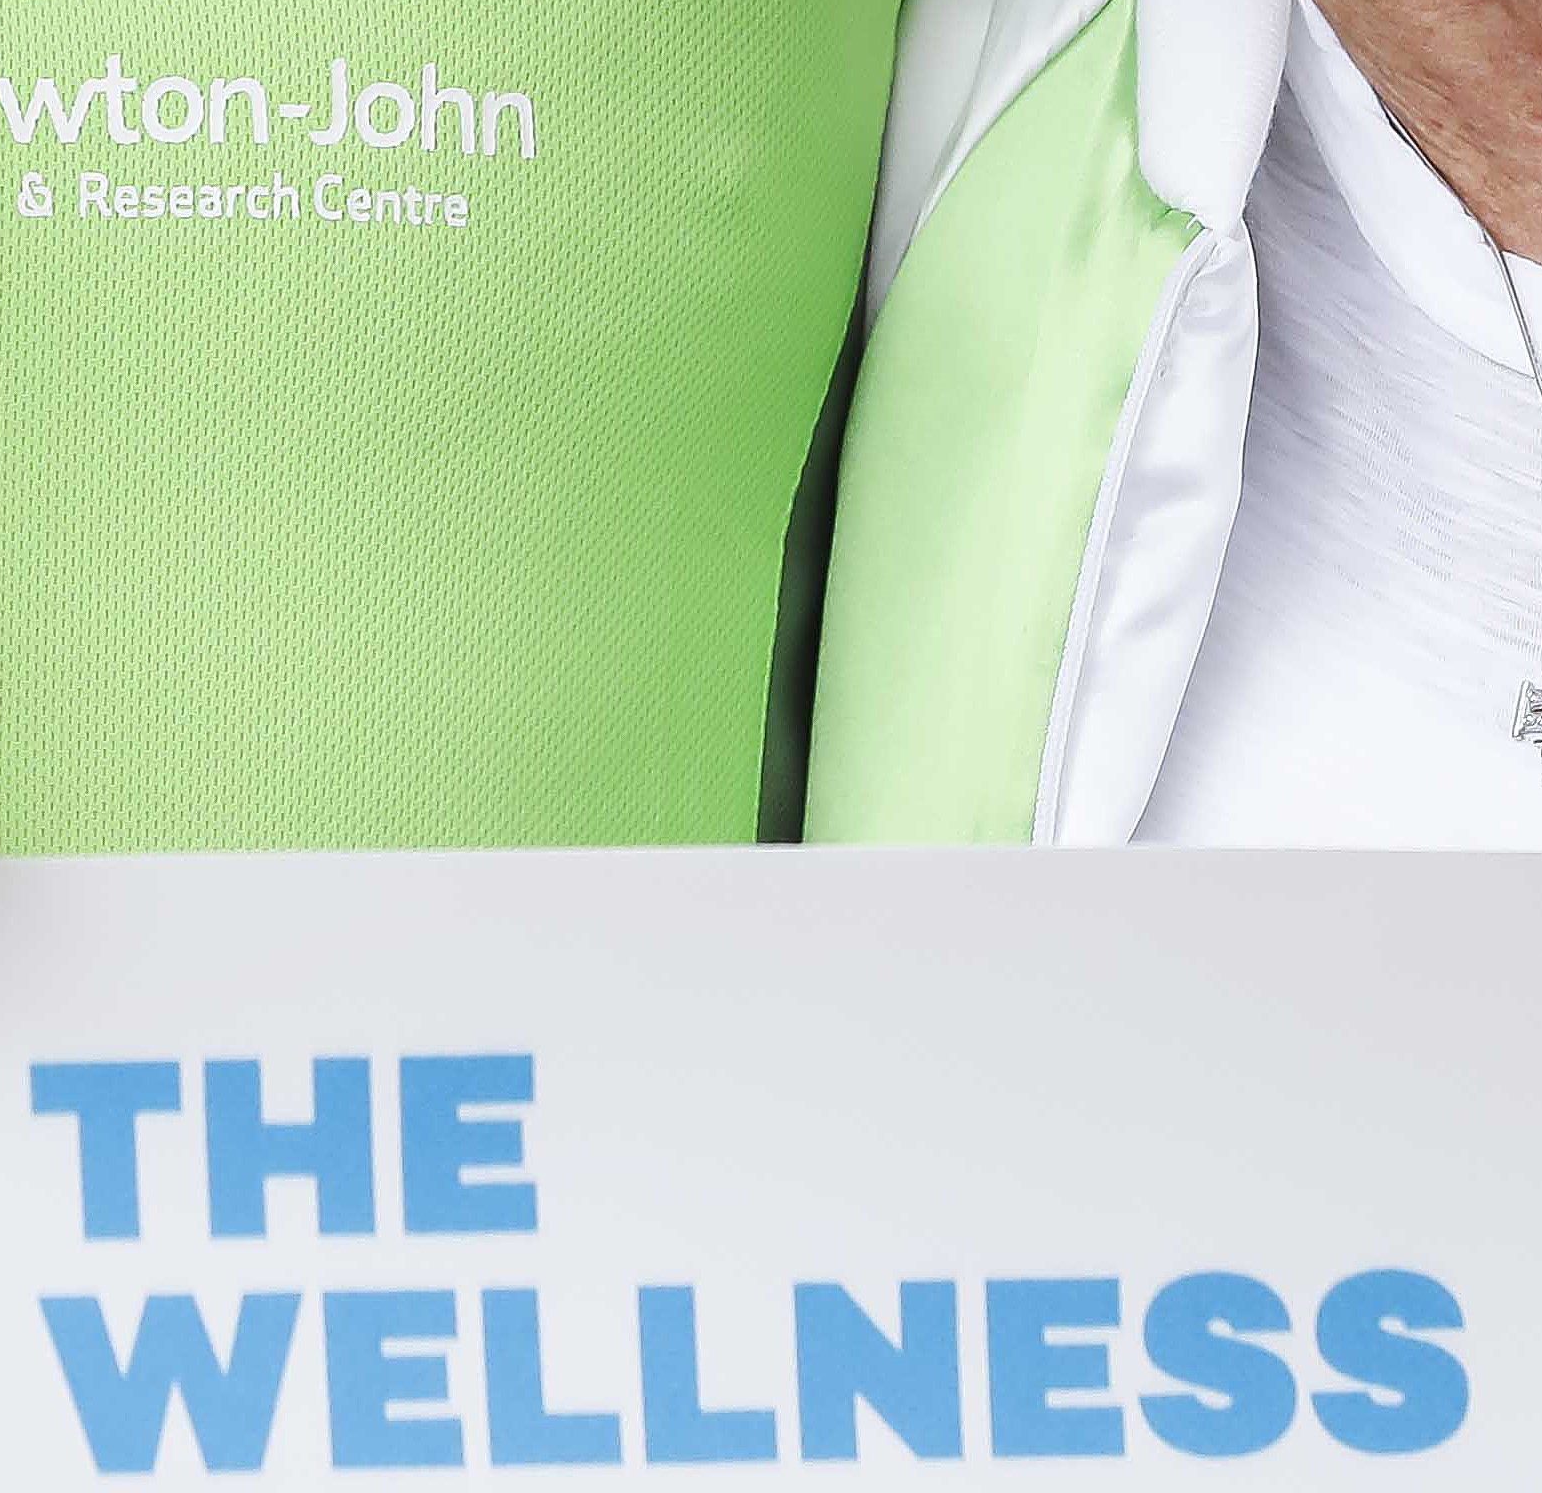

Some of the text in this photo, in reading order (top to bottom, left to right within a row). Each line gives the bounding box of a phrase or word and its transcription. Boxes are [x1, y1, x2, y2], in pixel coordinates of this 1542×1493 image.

[17, 171, 53, 218] &
[78, 171, 301, 220] Research
[314, 173, 469, 228] Centre
[28, 1052, 539, 1242] THE
[37, 1267, 1471, 1475] WELLNESS
